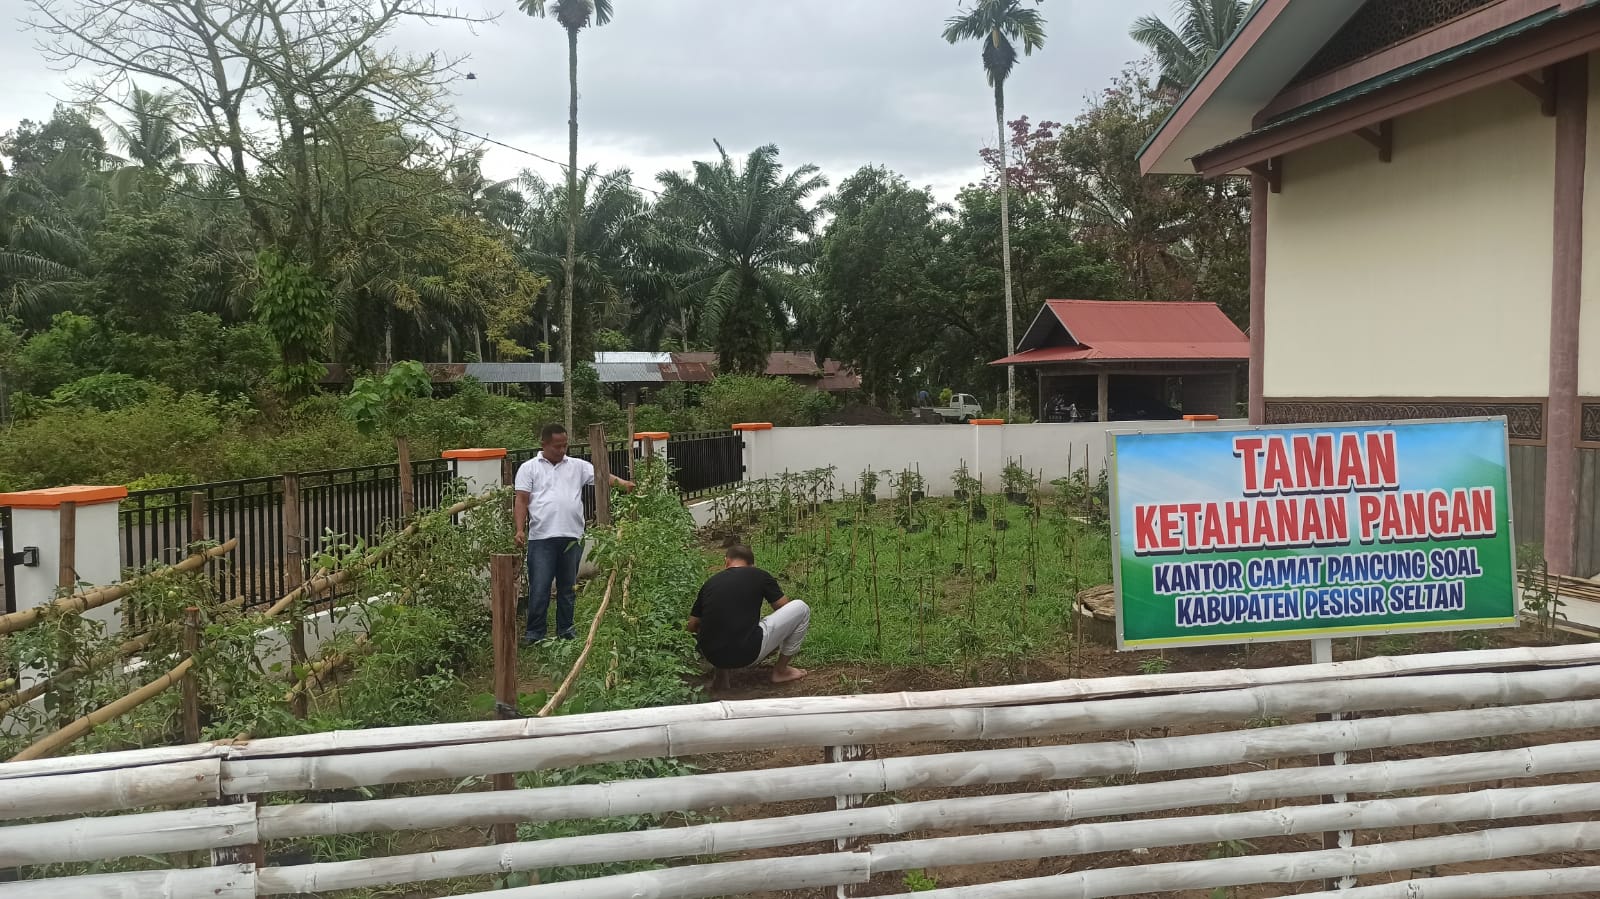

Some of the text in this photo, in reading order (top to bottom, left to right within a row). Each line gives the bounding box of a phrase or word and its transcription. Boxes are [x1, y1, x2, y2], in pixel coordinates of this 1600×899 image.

[1235, 431, 1398, 491] TAMAN
[1134, 489, 1495, 550] KETAHANAN PANGAN
[1154, 548, 1481, 593] KANTOR CAMAT PANCUNG SOAL
[1177, 582, 1464, 625] KABUPATEN PESISIR SELTAN
